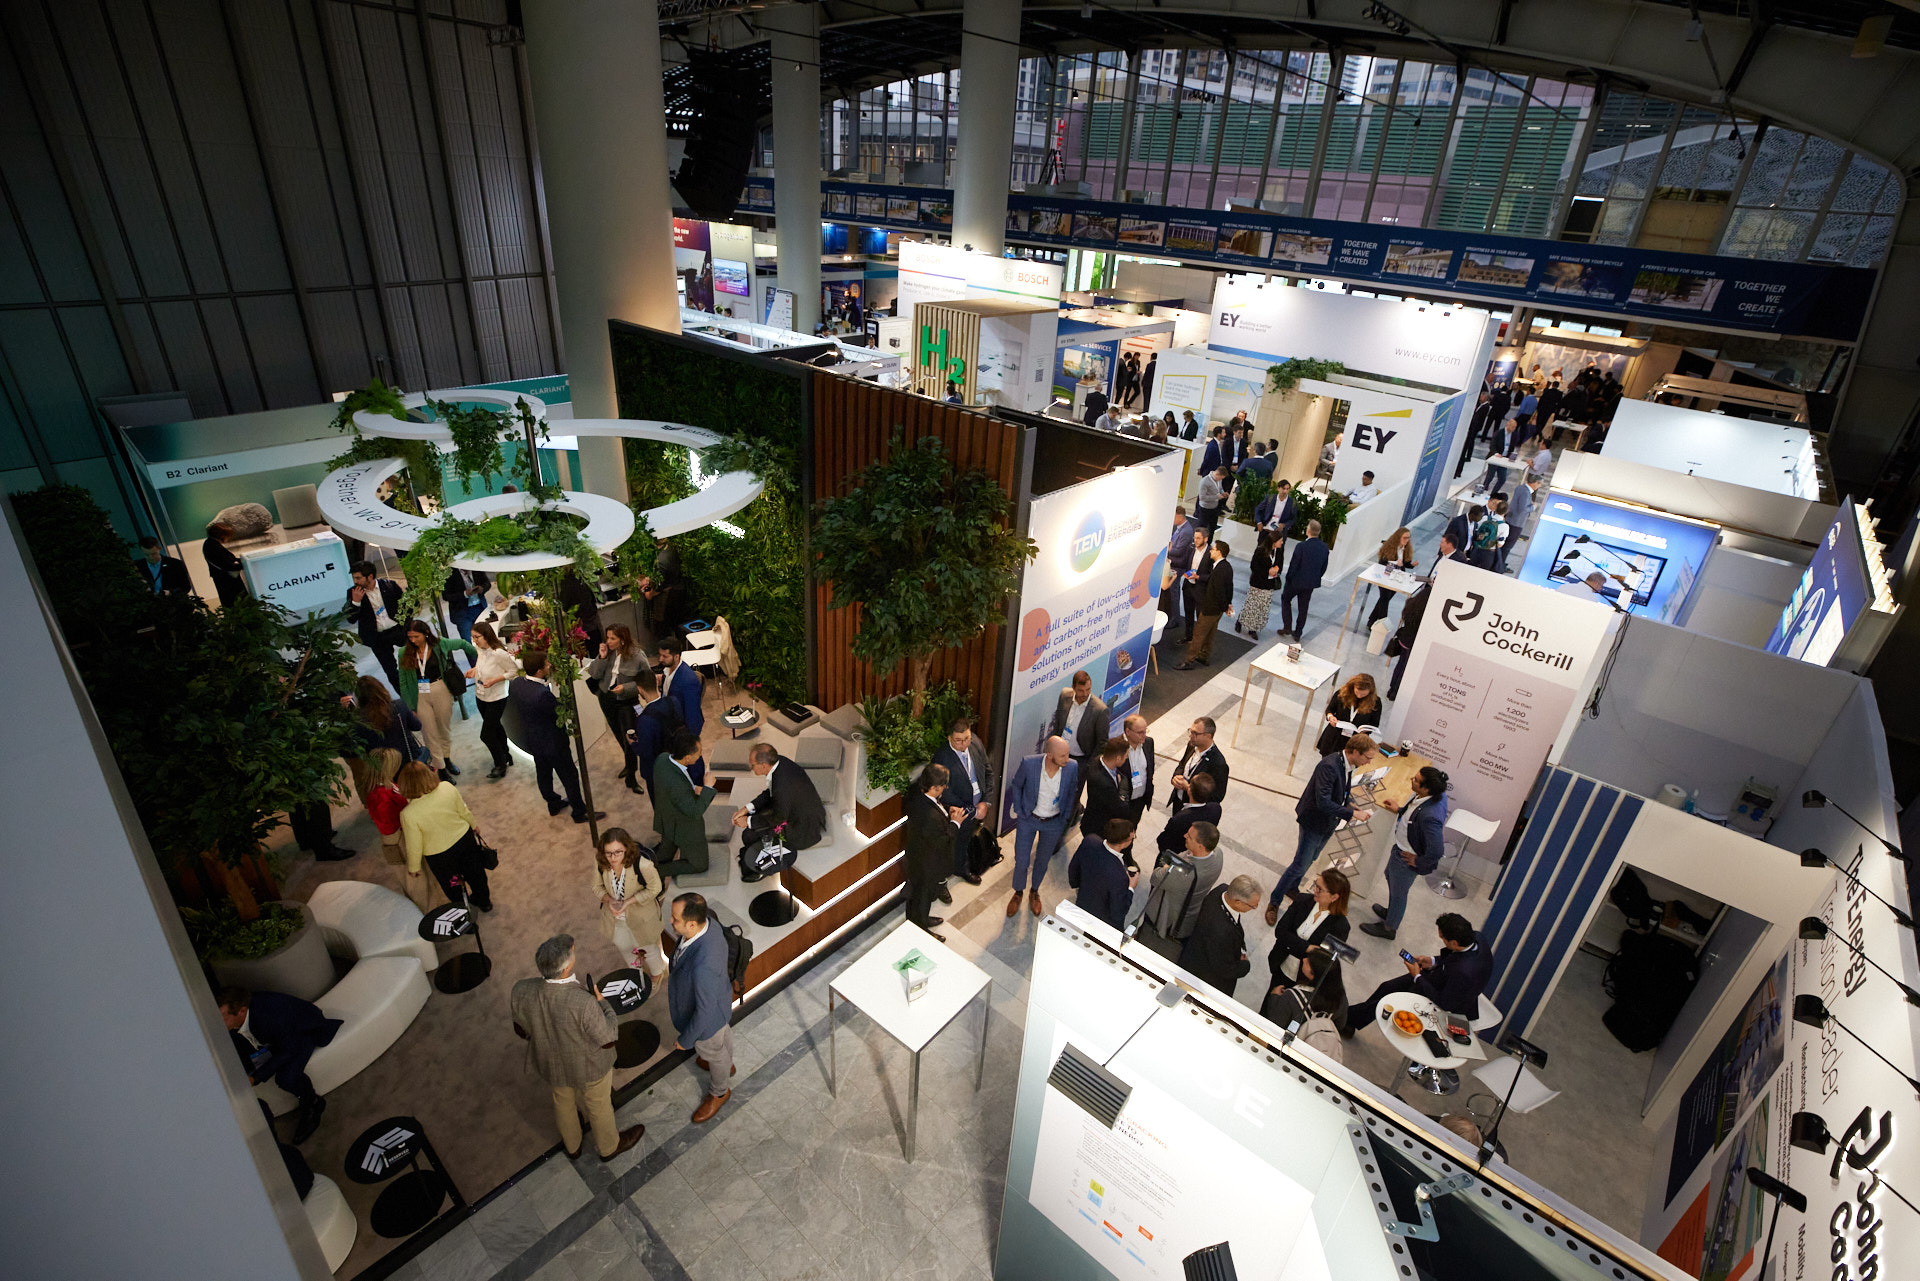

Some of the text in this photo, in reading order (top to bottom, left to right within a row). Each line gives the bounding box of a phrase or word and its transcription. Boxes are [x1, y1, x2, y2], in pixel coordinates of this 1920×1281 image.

[1343, 239, 1378, 250] TOGETHER
[1339, 256, 1369, 266] CREATED
[1341, 248, 1370, 258] WE HAVE
[1604, 259, 1624, 267] BICYCLE
[1018, 272, 1049, 286] BOSCH
[1733, 280, 1787, 294] TOGETHER
[1765, 294, 1782, 304] WE
[1737, 302, 1777, 314] CREATE
[1220, 312, 1241, 328] EY
[1395, 347, 1461, 366] www.ey.com
[529, 385, 566, 396] CLARIANT
[1351, 423, 1398, 454] EY
[166, 462, 229, 479] B2 Clariant
[1107, 522, 1142, 543] ENERGIES
[268, 571, 327, 591] CLARIANT
[1035, 579, 1141, 639] A full suite of low-carbon
[1033, 594, 1139, 657] and carbon-free hydrogen
[1488, 613, 1540, 642] John
[1031, 624, 1110, 673] solutions for clean
[1482, 630, 1574, 671] Cockerill
[1029, 642, 1102, 689] energy transition
[1448, 685, 1467, 697] TONS
[1506, 697, 1520, 705] More
[1485, 750, 1498, 758] More
[1494, 763, 1509, 772] MW
[1844, 843, 1867, 998] The Energy
[1856, 1168, 1883, 1281] John
[1796, 1222, 1806, 1281] Mobility
